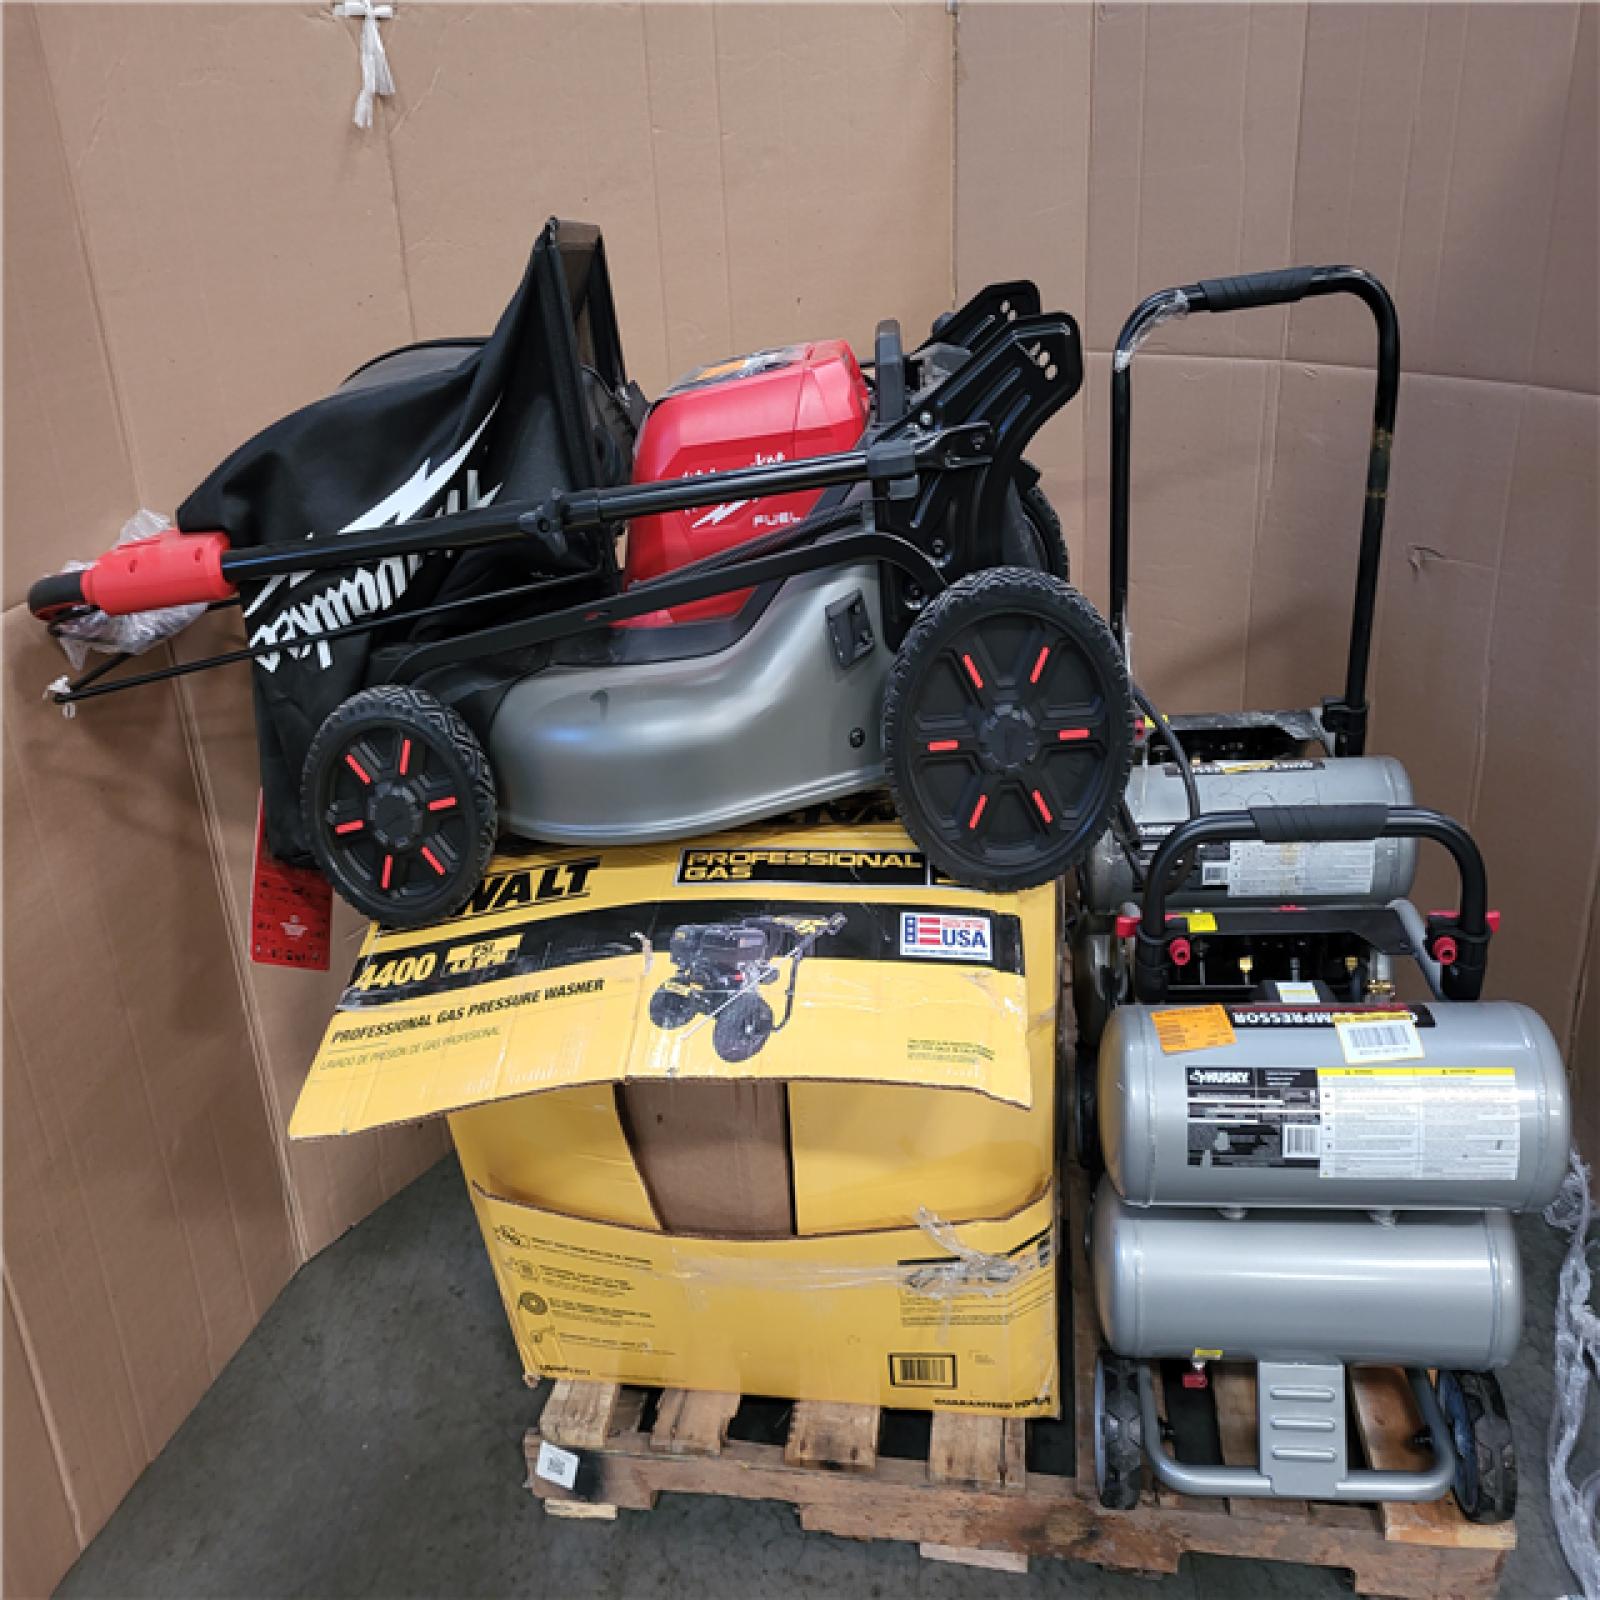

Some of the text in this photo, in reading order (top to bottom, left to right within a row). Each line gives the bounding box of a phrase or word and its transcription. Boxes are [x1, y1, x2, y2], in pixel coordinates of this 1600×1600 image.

[684, 866, 752, 881] GAS
[687, 851, 922, 869] PROFESSIONAL
[455, 860, 599, 916] WALT
[942, 929, 986, 948] USA
[353, 951, 437, 992] 4400
[332, 978, 606, 1044] PROFESSIONAL GAS PRESSURE WASHER
